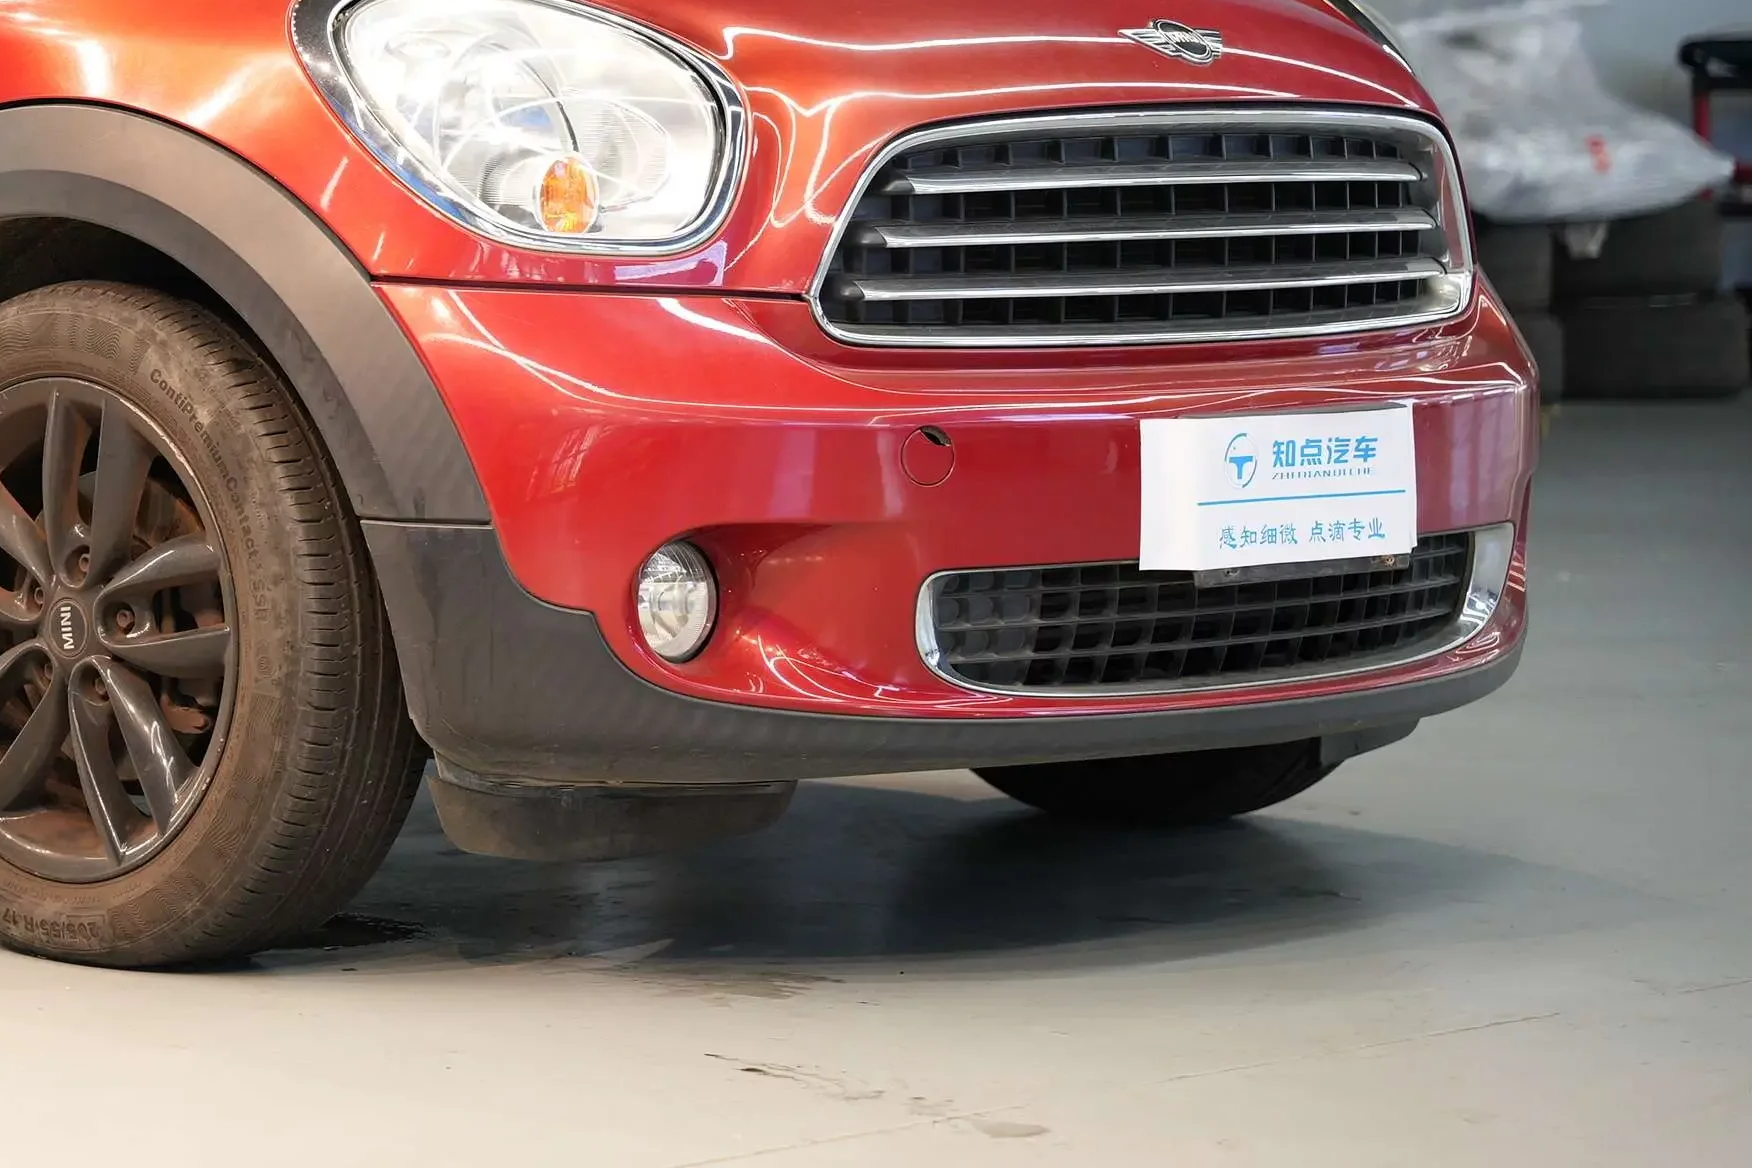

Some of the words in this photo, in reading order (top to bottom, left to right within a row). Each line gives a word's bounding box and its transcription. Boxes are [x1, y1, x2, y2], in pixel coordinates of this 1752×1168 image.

[1271, 436, 1379, 468] 知点汽车
[1218, 522, 1299, 550] 感知细微
[1308, 516, 1387, 543] 点滴专业
[60, 606, 75, 650] MINI
